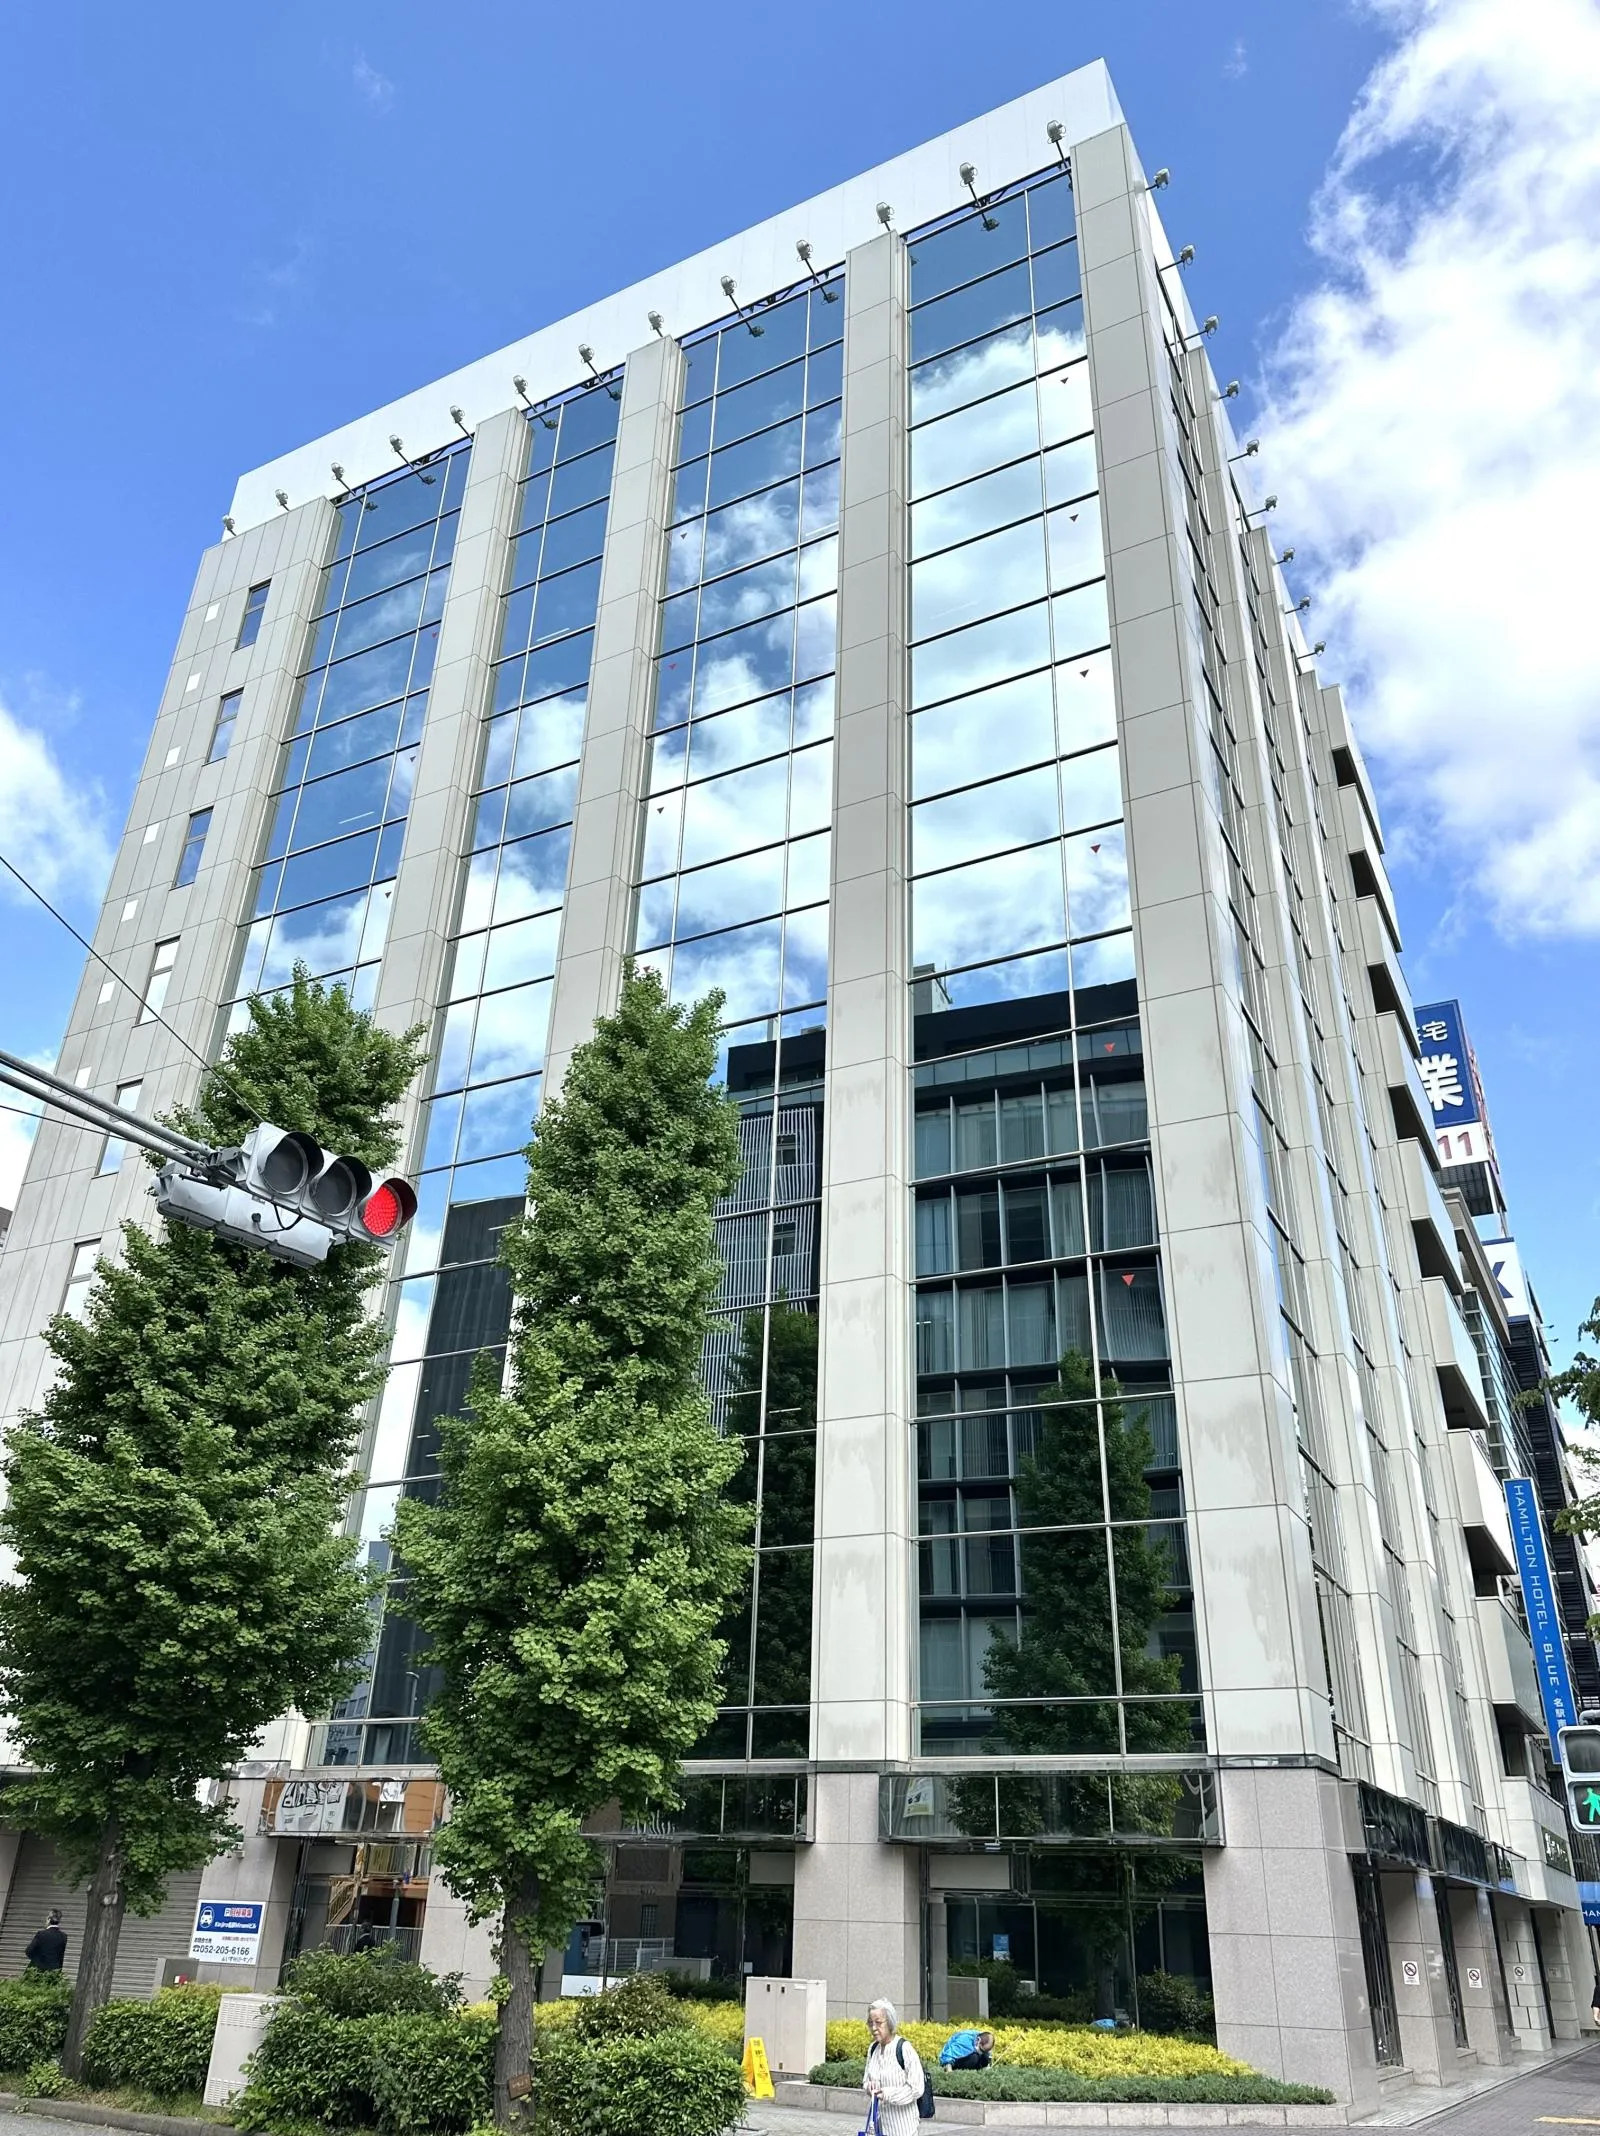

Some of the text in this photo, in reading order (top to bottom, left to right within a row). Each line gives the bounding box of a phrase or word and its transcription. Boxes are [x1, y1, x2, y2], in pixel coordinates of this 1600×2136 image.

[1513, 1484, 1538, 1568] HAMILTON
[1529, 1575, 1549, 1631] HOTEL
[199, 1945, 250, 1956] 052-205-6166
